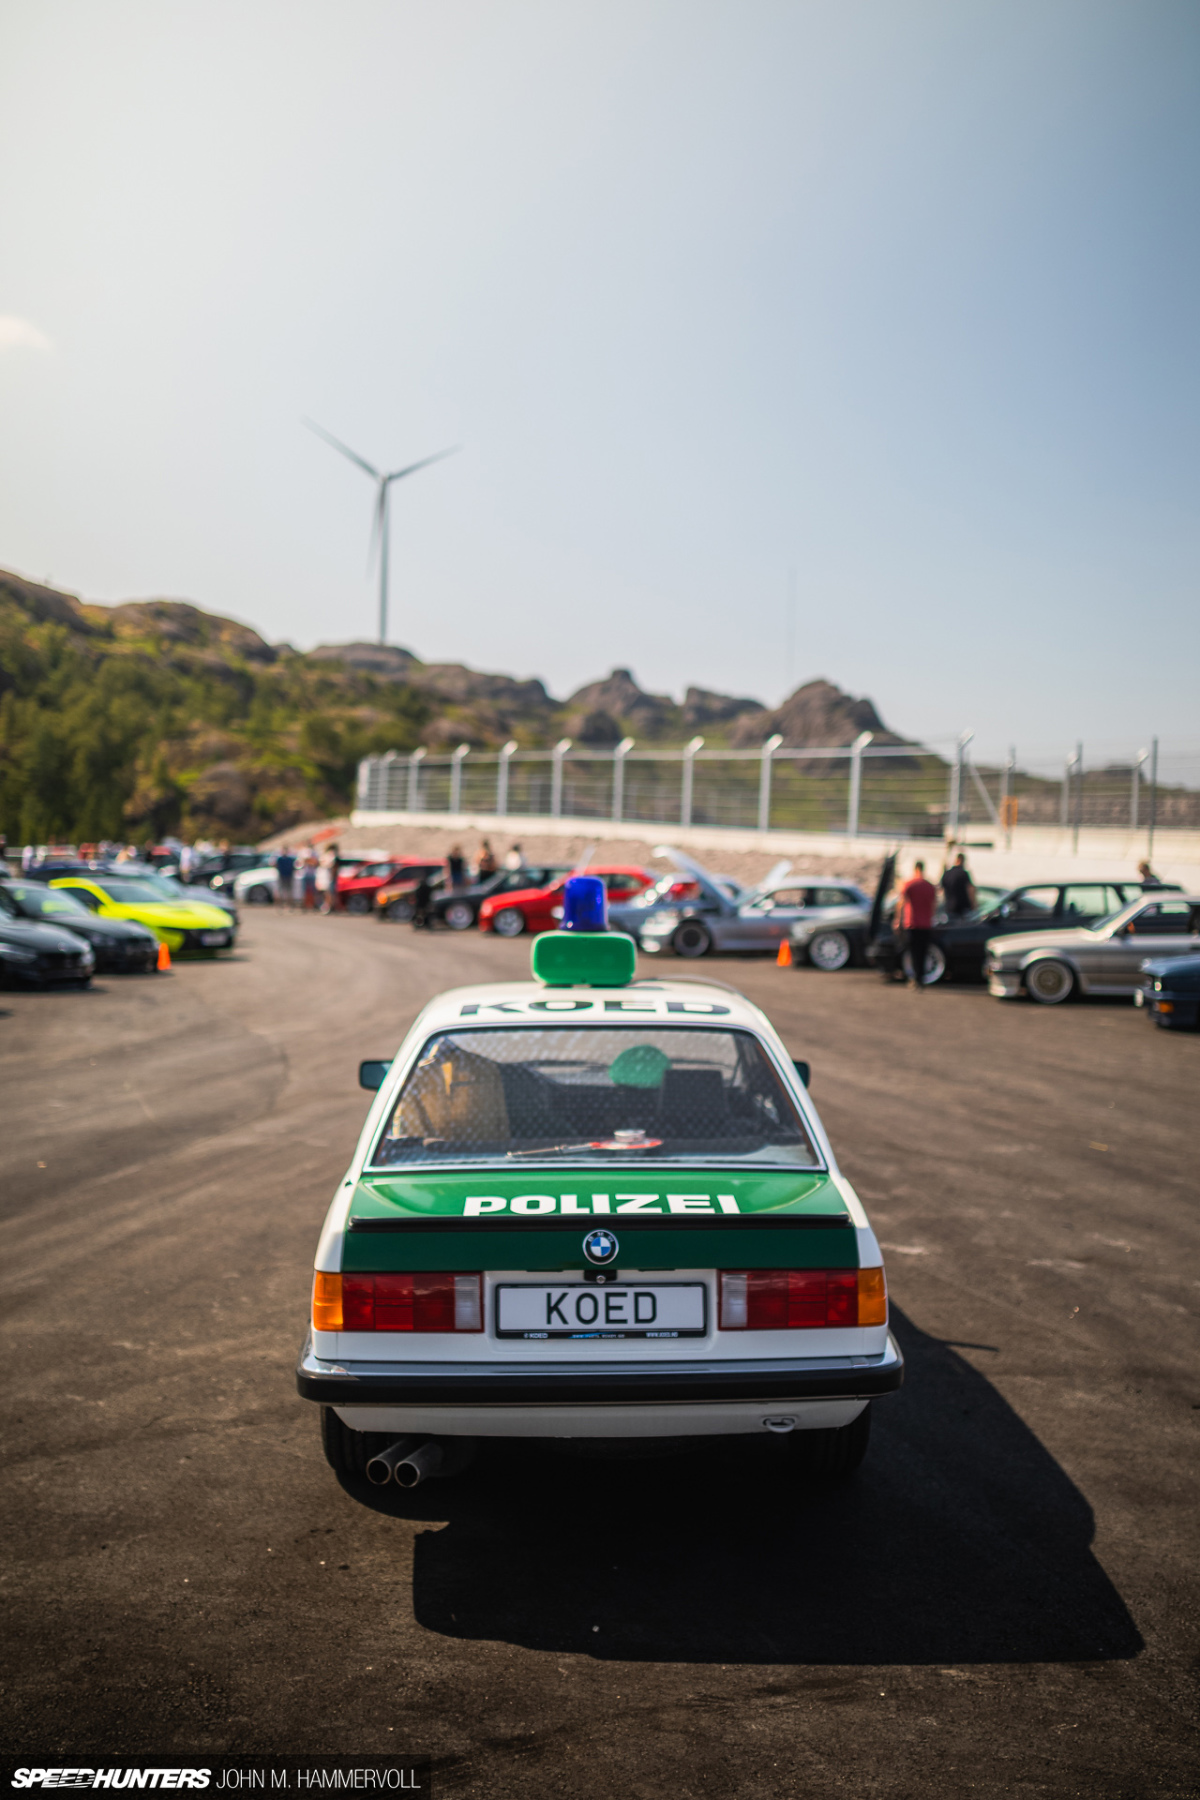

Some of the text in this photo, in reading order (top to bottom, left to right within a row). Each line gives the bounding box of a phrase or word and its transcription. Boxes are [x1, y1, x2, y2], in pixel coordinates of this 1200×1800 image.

[460, 1000, 731, 1016] KOED
[463, 1194, 741, 1216] POLIZEI
[546, 1292, 657, 1325] KOED
